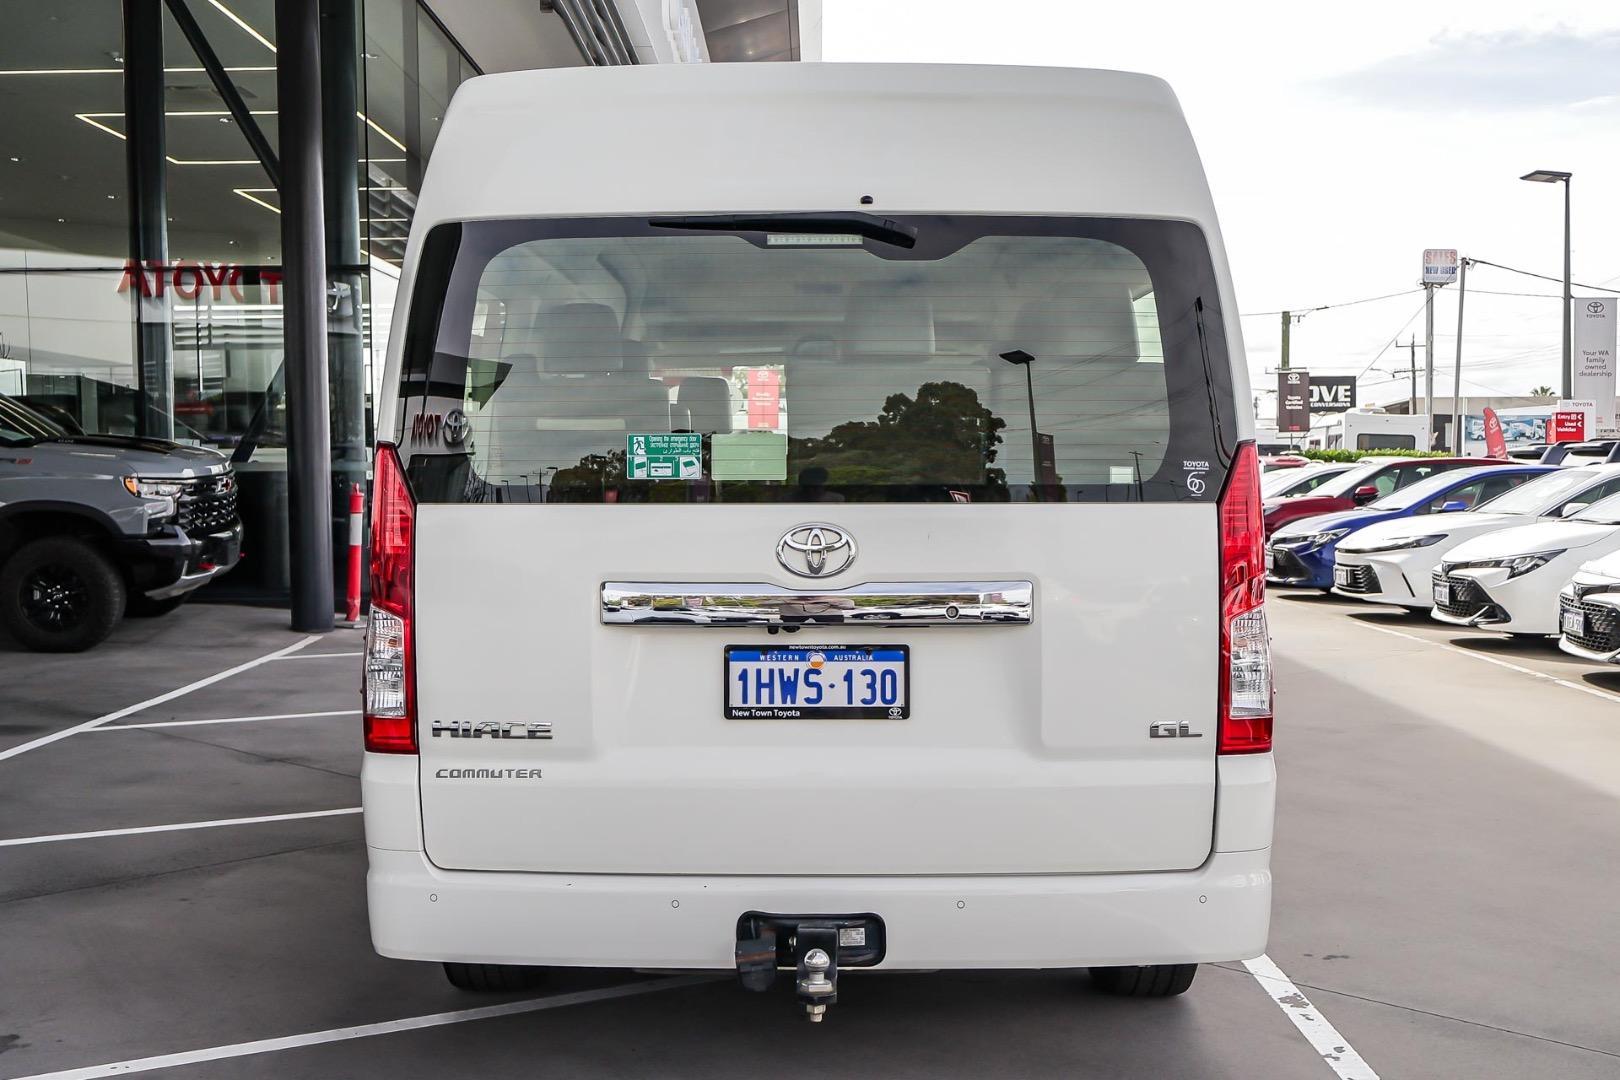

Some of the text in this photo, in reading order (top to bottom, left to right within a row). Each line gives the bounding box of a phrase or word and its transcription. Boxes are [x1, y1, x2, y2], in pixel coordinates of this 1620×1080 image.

[1557, 413, 1571, 421] Entry
[774, 709, 800, 718] Toyota
[432, 720, 553, 739] HIACE
[1150, 720, 1203, 738] GL
[435, 768, 543, 779] COMMUTER
